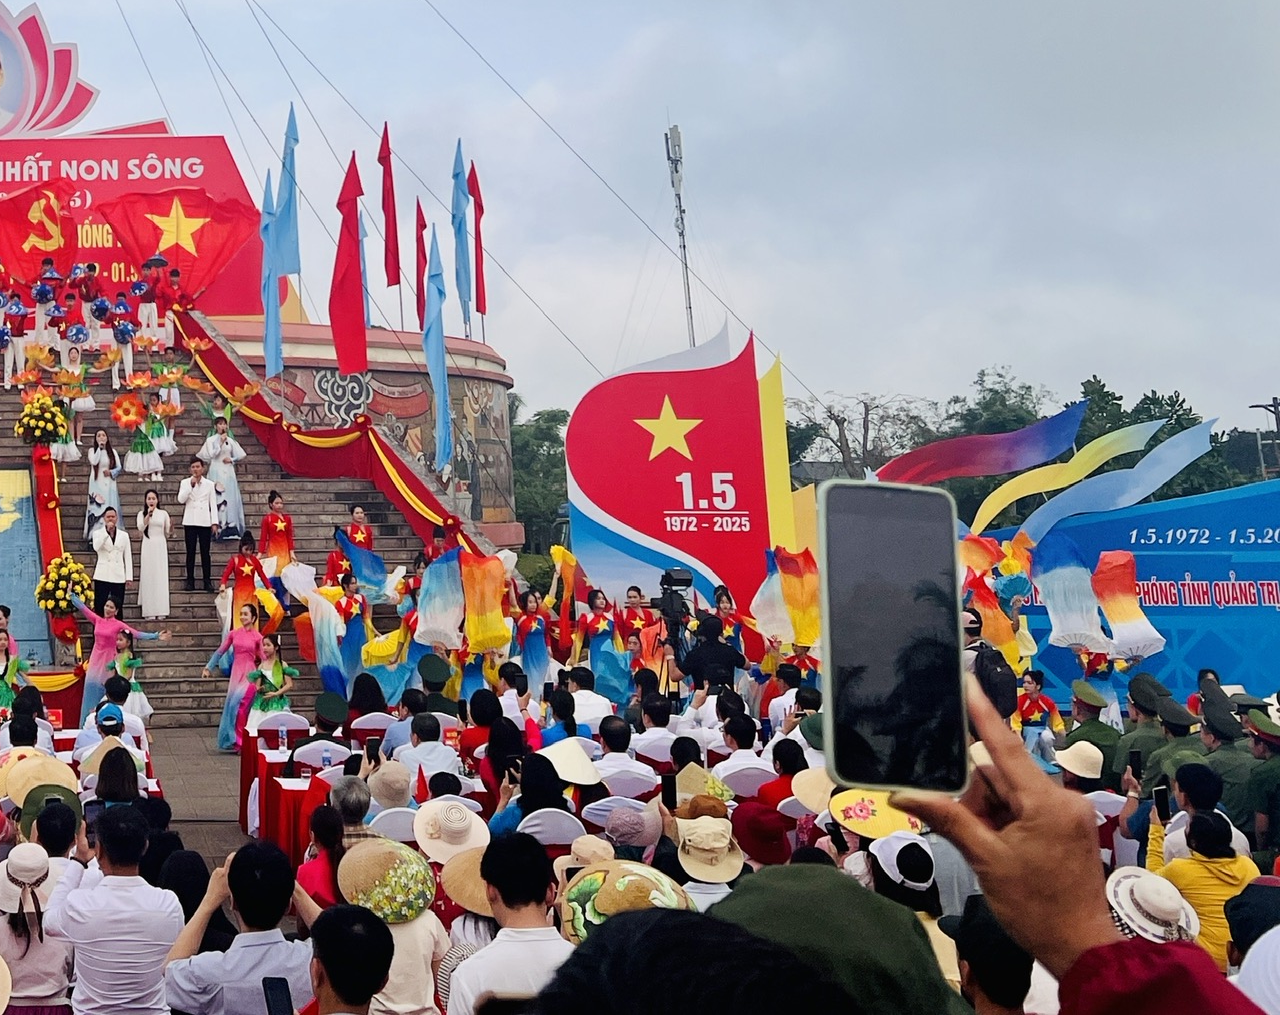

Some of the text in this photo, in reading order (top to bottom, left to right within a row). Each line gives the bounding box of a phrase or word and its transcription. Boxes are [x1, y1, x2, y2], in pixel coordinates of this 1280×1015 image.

[60, 159, 119, 181] NON
[127, 153, 205, 180] SÔNG
[675, 472, 737, 511] 1.5
[664, 516, 698, 532] 1972
[713, 516, 751, 532] 2025
[1129, 528, 1210, 545] 1.5.1972
[1136, 576, 1178, 606] PHÓNG
[1179, 572, 1211, 606] TỈNH
[1213, 570, 1258, 609] QUẢNG
